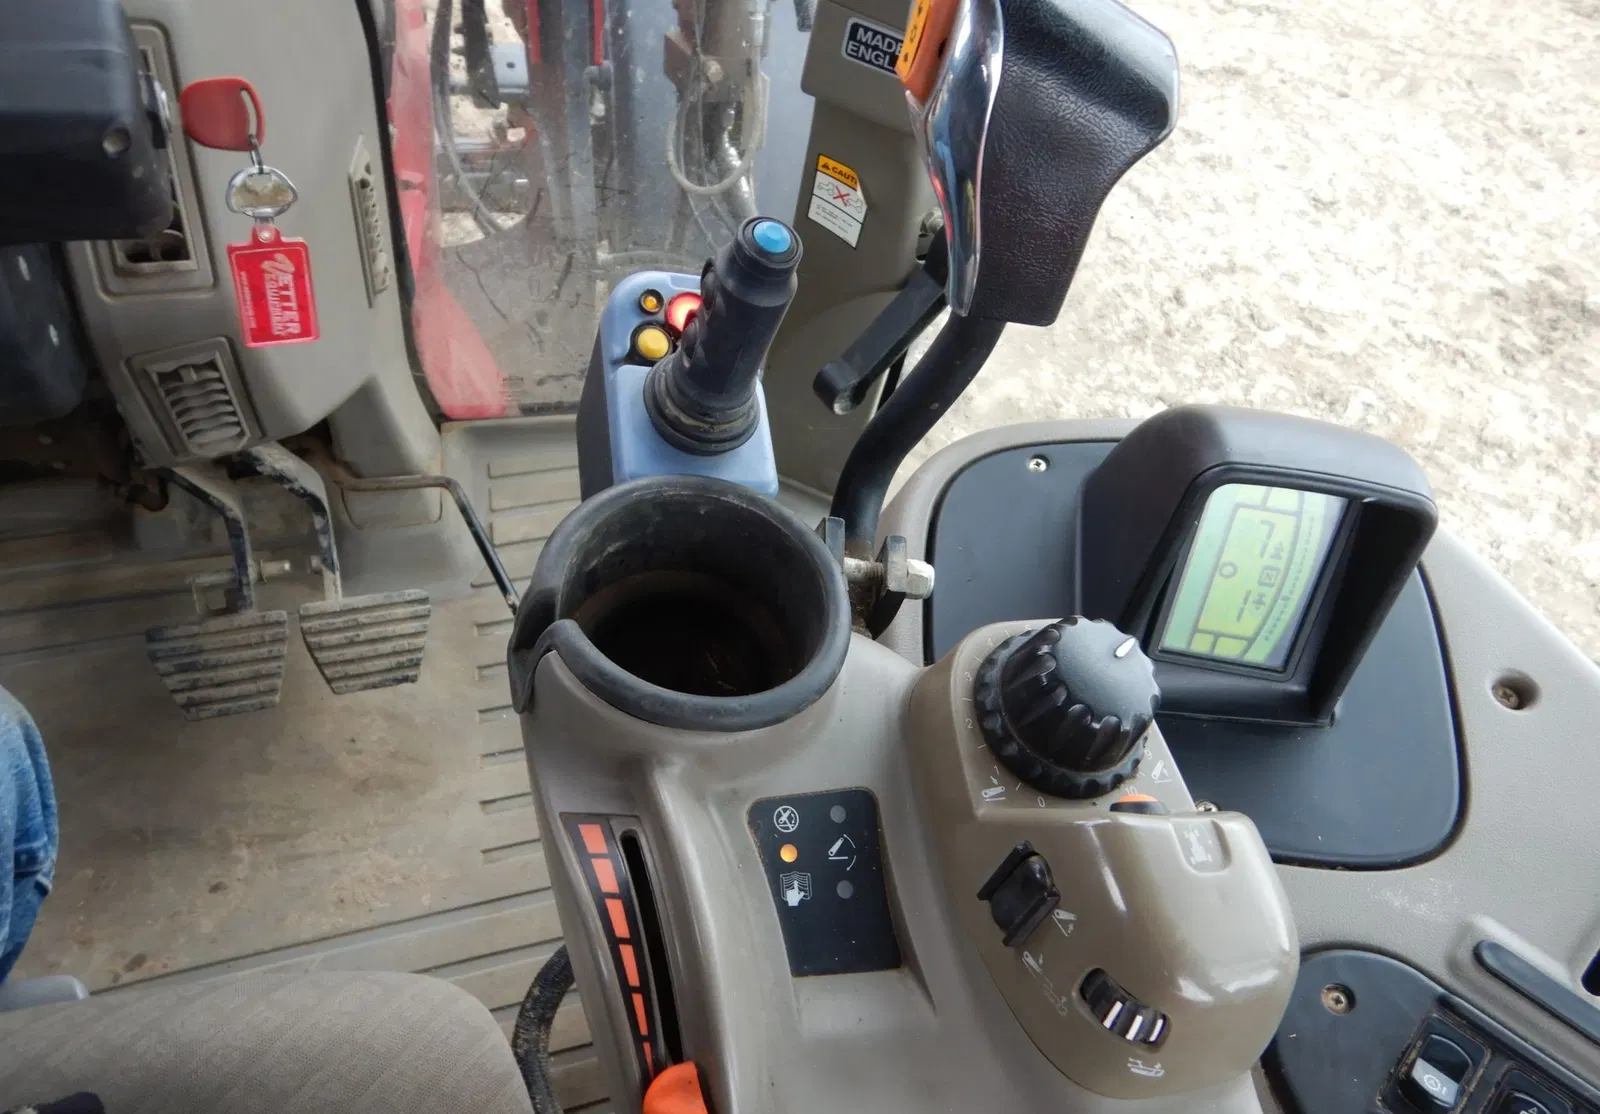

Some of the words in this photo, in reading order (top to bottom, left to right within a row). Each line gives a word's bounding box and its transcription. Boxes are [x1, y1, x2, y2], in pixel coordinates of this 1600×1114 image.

[260, 252, 301, 334] VETTER
[964, 671, 973, 682] 3
[965, 718, 974, 729] 2
[1144, 749, 1153, 760] 9
[1037, 796, 1046, 808] 0
